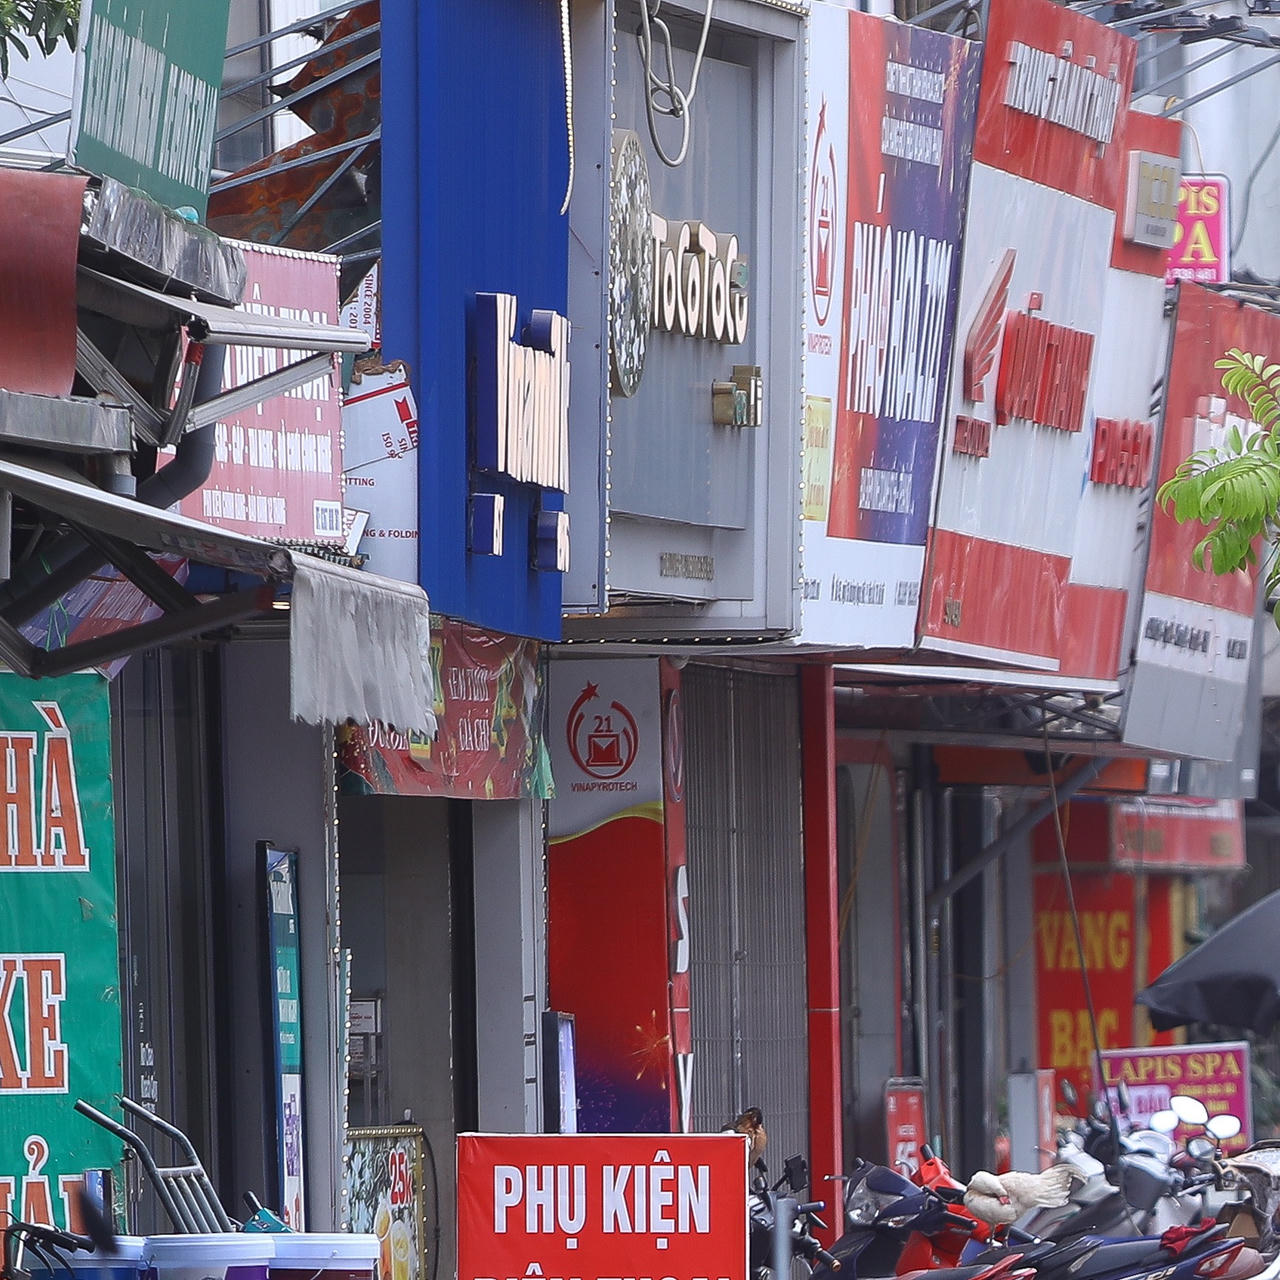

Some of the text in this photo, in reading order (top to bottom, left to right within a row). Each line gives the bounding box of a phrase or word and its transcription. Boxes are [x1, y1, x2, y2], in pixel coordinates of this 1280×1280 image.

[1006, 41, 1056, 118] TRUNG
[363, 274, 374, 325] SINCE 2004
[846, 172, 893, 419] PHÁO
[886, 229, 925, 422] HOA
[378, 529, 386, 538] &
[593, 715, 613, 733] 21
[571, 782, 638, 793] VINAPYROTECH
[1102, 1051, 1242, 1082] LAPIS SPA
[493, 1149, 711, 1250] PHỤ KIỆN
